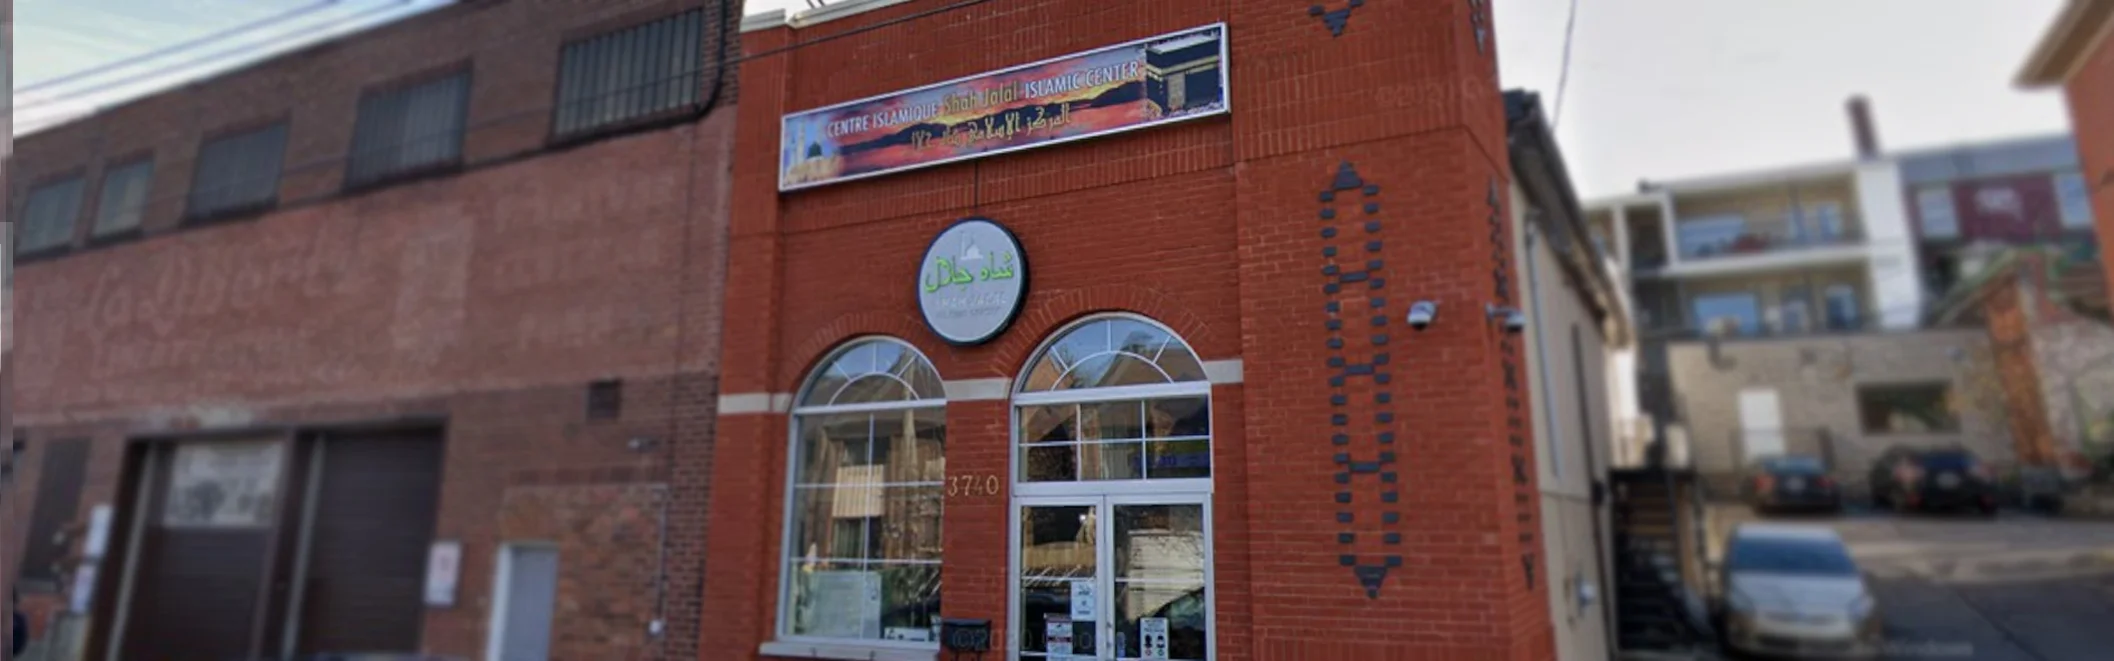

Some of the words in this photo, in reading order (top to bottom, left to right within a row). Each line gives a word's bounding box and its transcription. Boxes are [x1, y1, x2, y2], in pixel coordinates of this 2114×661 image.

[827, 114, 869, 138] CENTRE
[872, 102, 938, 129] ISLAMIQUE
[943, 91, 979, 115] Shah
[981, 80, 1018, 109] Jalal
[1024, 74, 1081, 99] ISLAMIC
[1085, 60, 1140, 88] CENTER
[1026, 102, 1071, 136] المركز
[979, 250, 1014, 281] شاه
[947, 474, 999, 498] 3740
